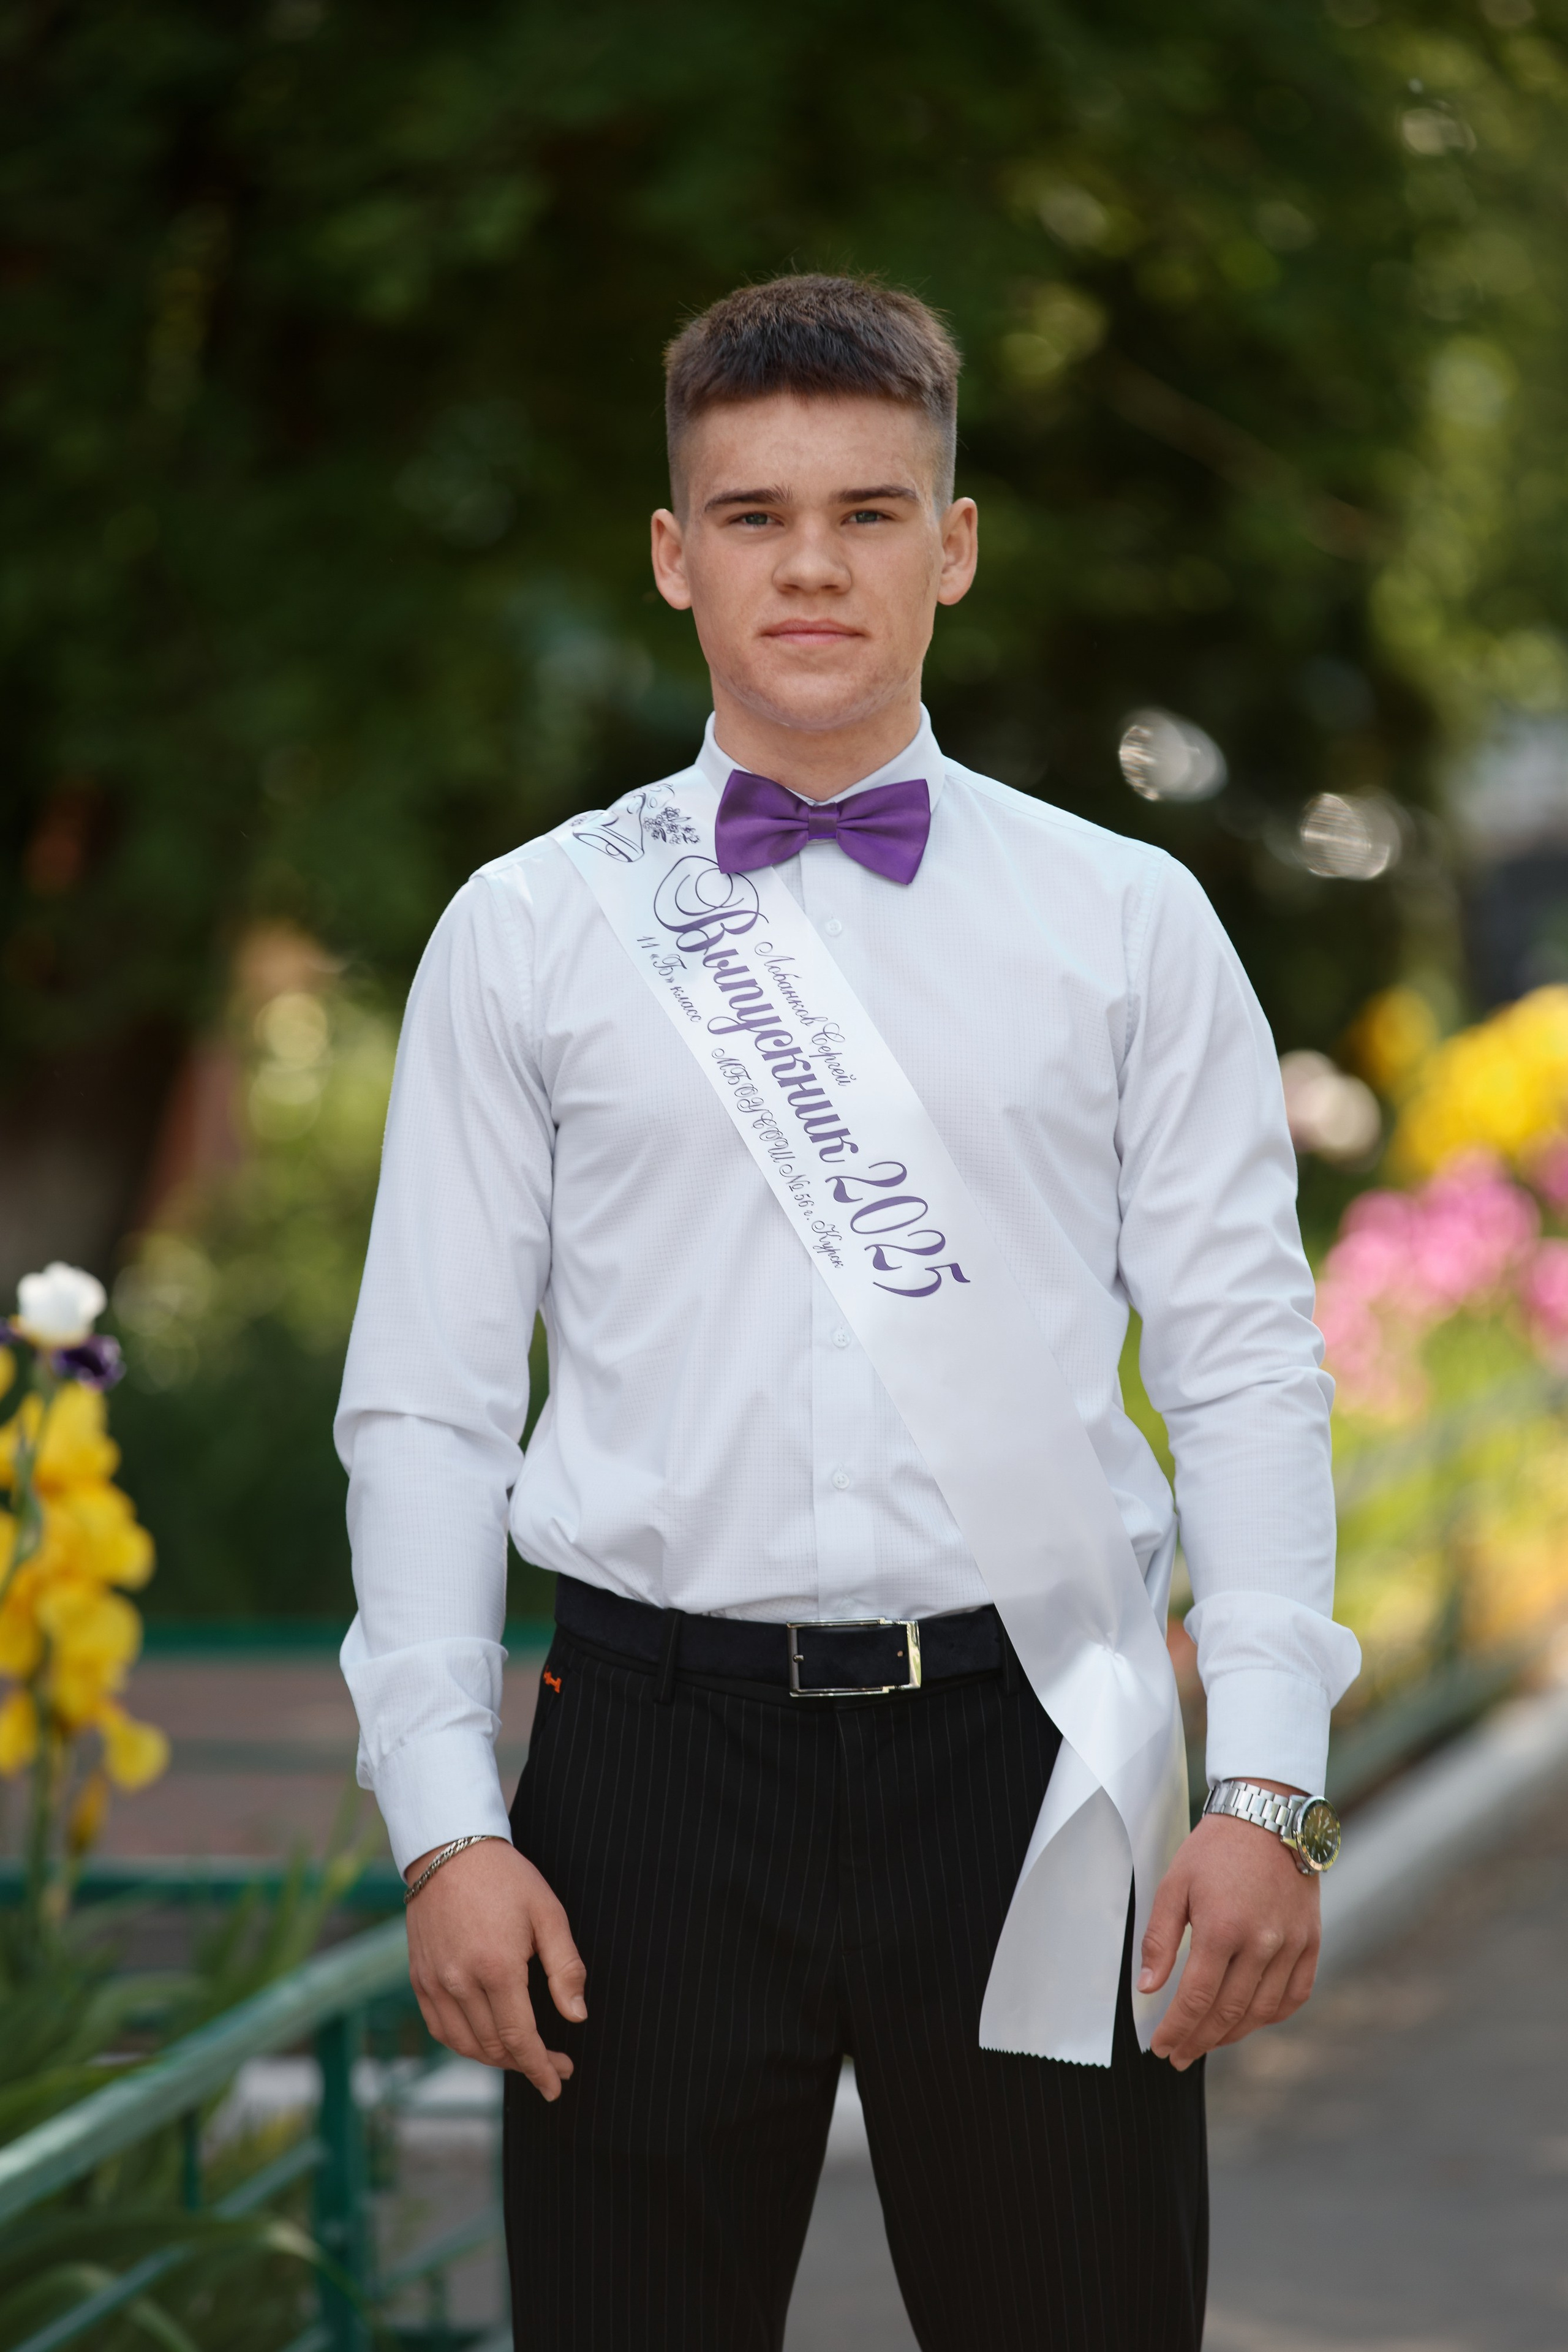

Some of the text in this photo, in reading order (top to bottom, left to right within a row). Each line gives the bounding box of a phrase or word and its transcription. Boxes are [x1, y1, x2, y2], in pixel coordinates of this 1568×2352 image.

[636, 936, 660, 948] 11
[669, 986, 702, 1023] класс
[811, 1219, 844, 1270] Курск
[654, 855, 971, 1298] Выпускник 2025
[754, 941, 857, 1087] Лобанков Сергей
